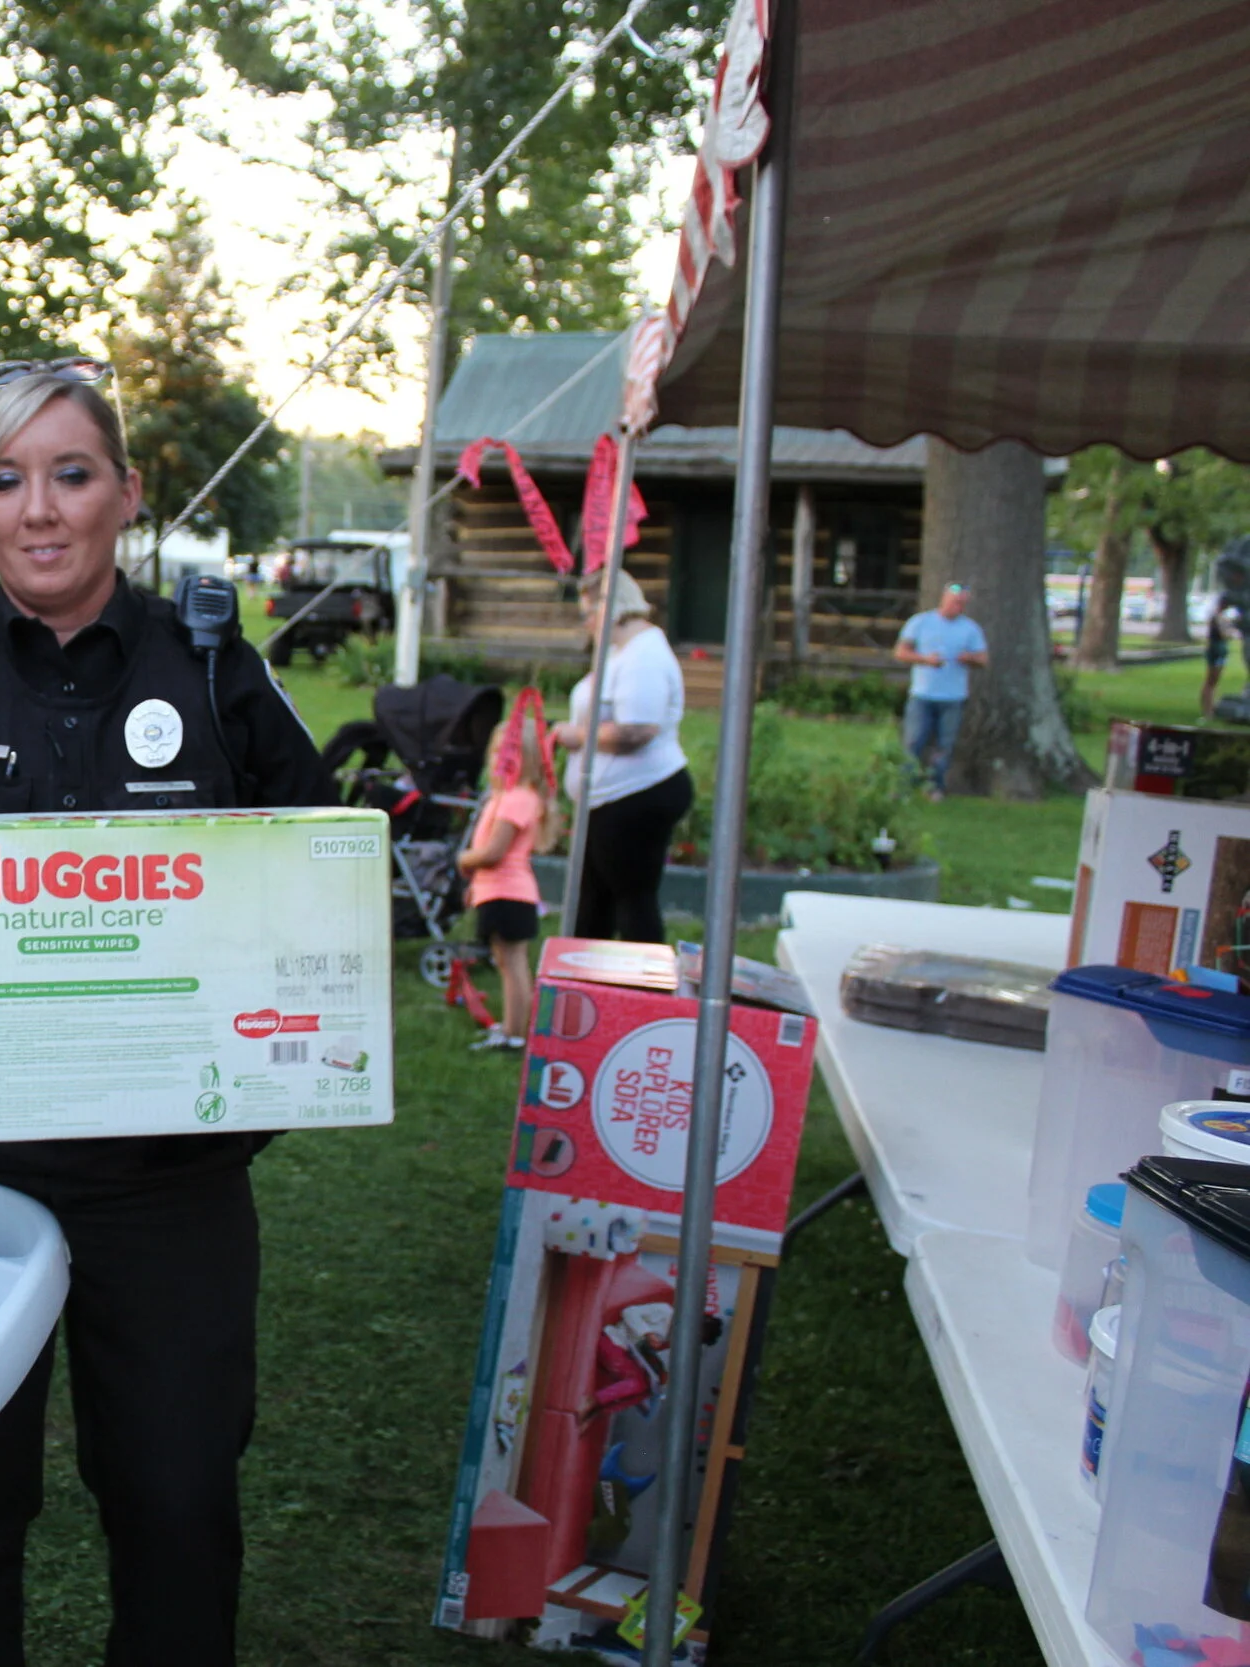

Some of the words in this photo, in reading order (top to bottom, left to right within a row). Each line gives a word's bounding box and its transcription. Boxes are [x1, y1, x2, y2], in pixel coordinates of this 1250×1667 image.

[101, 907, 164, 928] care
[24, 939, 90, 951] SENSITIVE
[94, 937, 134, 949] WIPES
[339, 1076, 371, 1092] 768
[611, 1068, 642, 1122] SOFA
[632, 1046, 673, 1156] EXPLORER
[662, 1079, 694, 1131] KIDS
